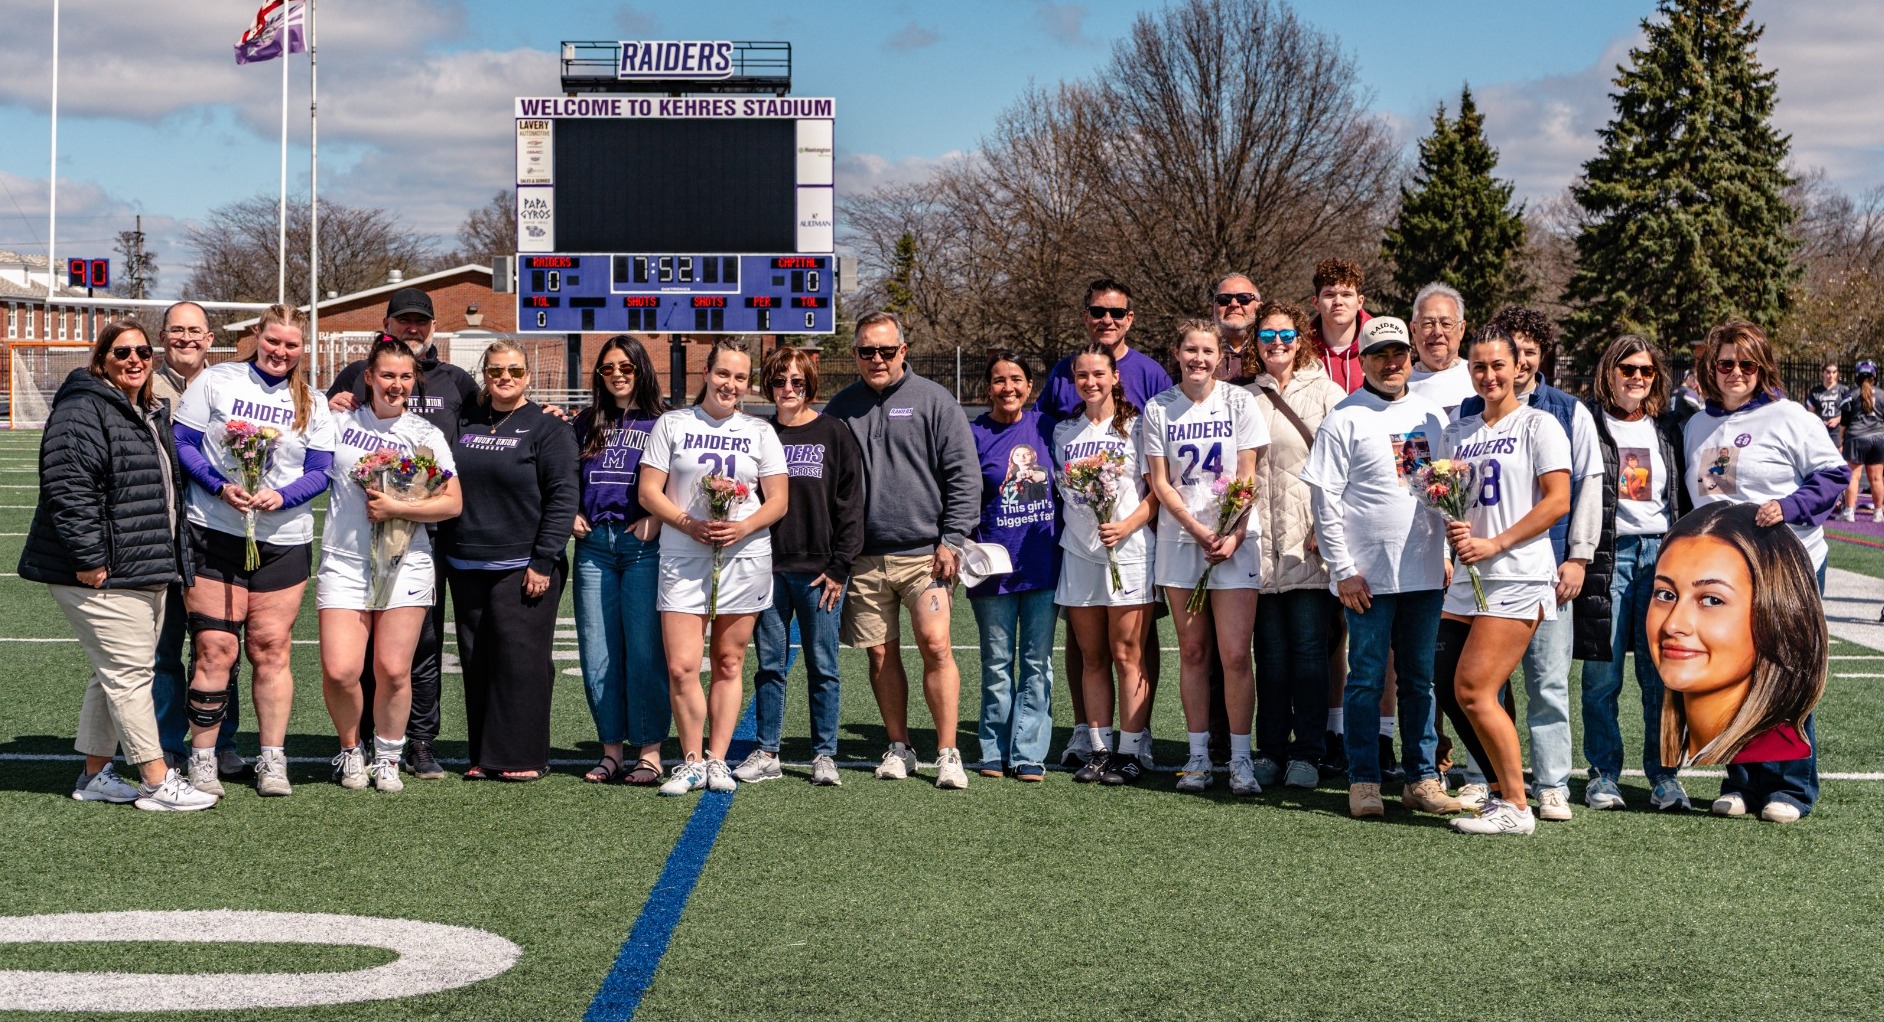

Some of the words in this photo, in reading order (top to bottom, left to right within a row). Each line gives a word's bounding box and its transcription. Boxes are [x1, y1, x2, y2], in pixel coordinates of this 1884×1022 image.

[620, 42, 732, 72] RAIDERS
[521, 99, 621, 116] WELCOME
[628, 99, 651, 116] TO
[659, 99, 736, 116] KEHRES
[743, 99, 832, 116] STADIUM
[519, 121, 549, 130] LAVERY
[524, 198, 547, 209] PAPA
[520, 210, 551, 219] GYROS
[533, 257, 571, 267] RAIDERS
[778, 257, 817, 268] CAPITAL
[71, 259, 106, 286] 90
[548, 271, 560, 291] 0
[807, 271, 819, 291] 0
[532, 296, 549, 307] TOL
[627, 296, 657, 307] SHOTS
[694, 297, 724, 307] SHOTS
[753, 297, 771, 307] PER
[801, 297, 818, 307] TOL
[537, 311, 547, 327] 0
[805, 312, 815, 328] 0
[1370, 322, 1404, 336] RAIDERS
[231, 398, 297, 427] RAIDER
[1821, 401, 1836, 417] 25
[1168, 420, 1233, 443] RAIDERS
[683, 433, 751, 455] RAIDERS
[602, 448, 627, 469] M
[783, 444, 825, 463] DERS
[1177, 442, 1224, 486] 24
[787, 466, 822, 479] ACROSSE
[1001, 503, 1026, 515] This
[1027, 499, 1053, 514] girl's
[996, 513, 1039, 528] biggest
